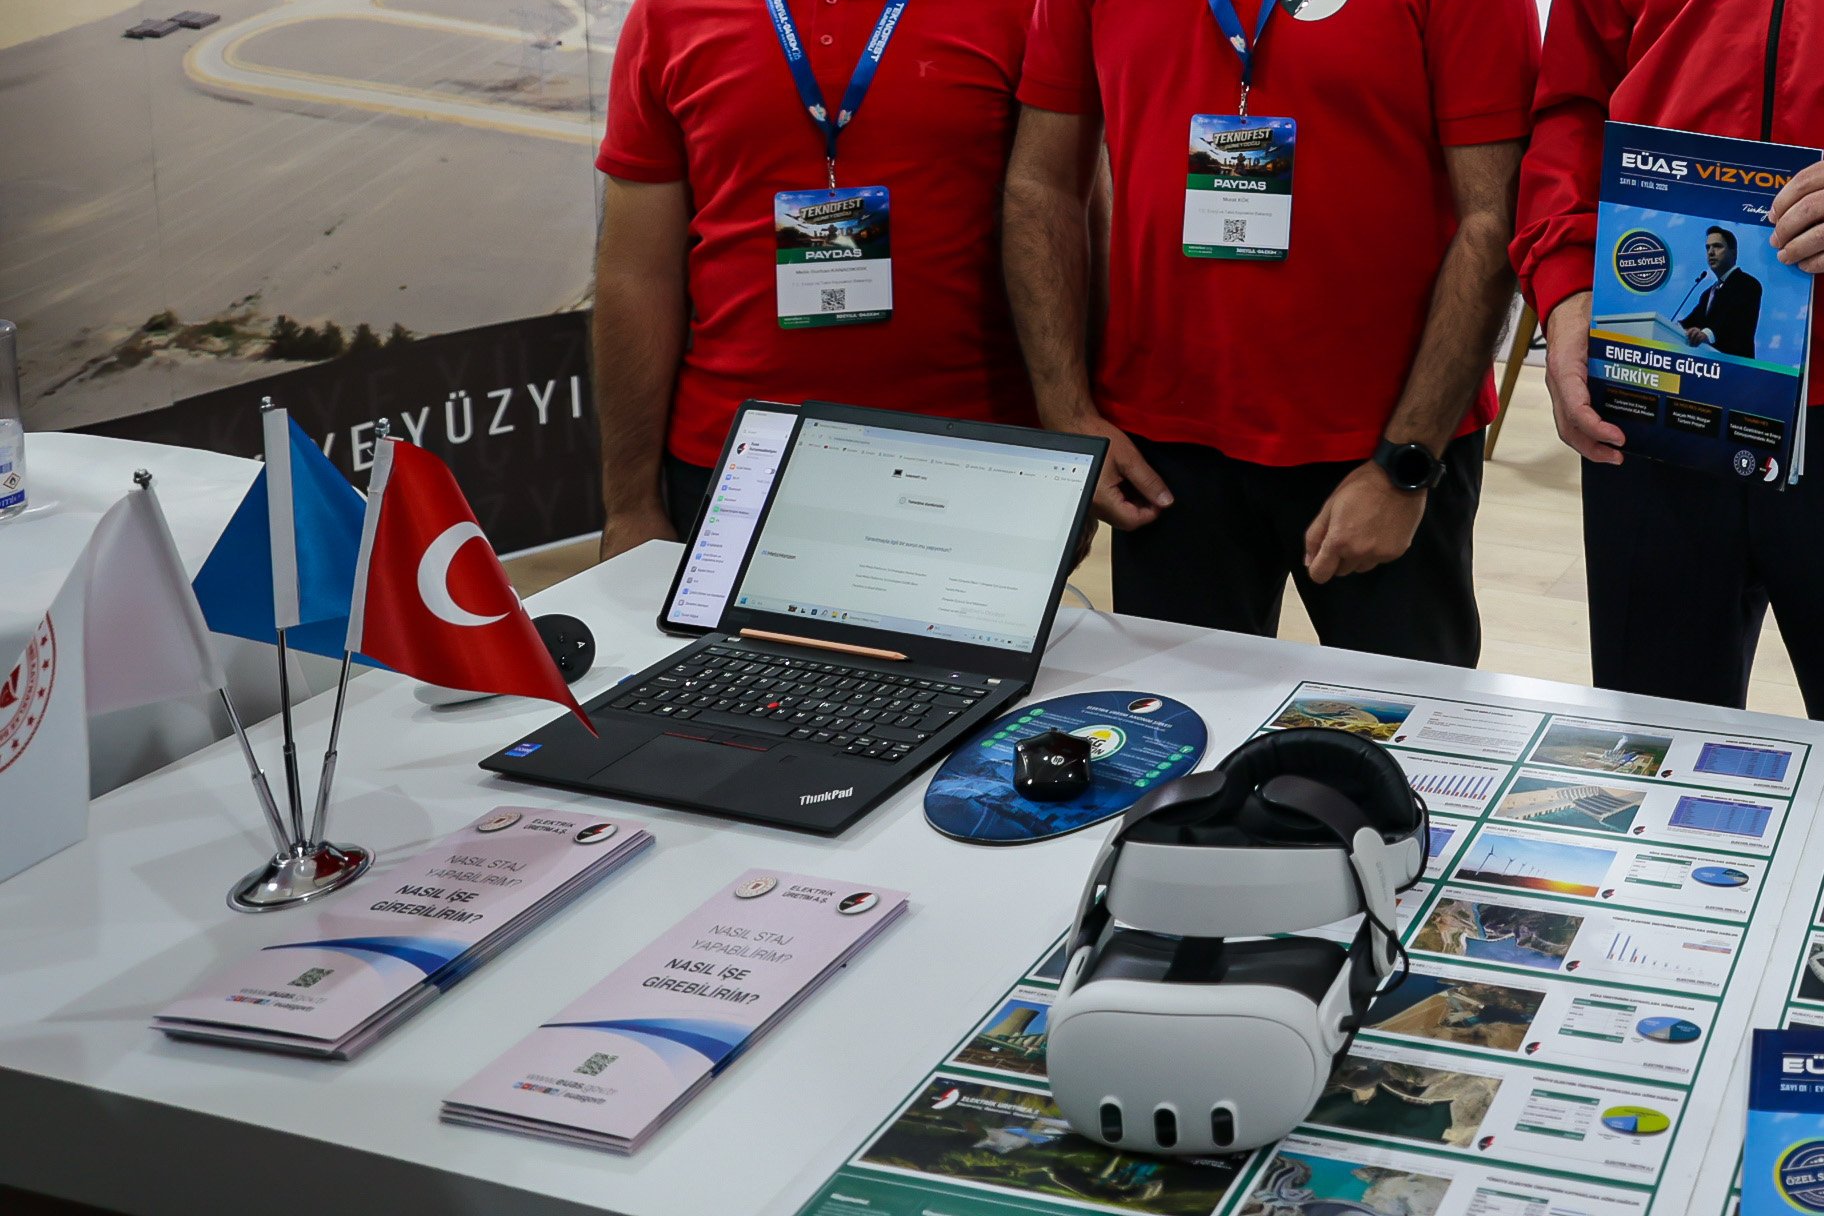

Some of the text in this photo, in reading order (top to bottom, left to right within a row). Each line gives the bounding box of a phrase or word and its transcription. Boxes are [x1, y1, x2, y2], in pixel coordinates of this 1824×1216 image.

[871, 2, 904, 62] TEKNOFEST
[1213, 127, 1272, 145] TEKNOFEST
[1621, 151, 1793, 189] EÜAŞ VİZYON
[801, 198, 863, 218] TEKNOFEST
[1619, 255, 1666, 268] ÖZEL SÖYLEŞİ
[1605, 345, 1721, 379] ENERJİDE GÜÇLÜ
[1604, 363, 1659, 387] TÜRKİYE
[401, 375, 582, 447] YÜZYI
[799, 787, 853, 806] ThinkPad
[532, 817, 576, 828] ELEKTRİK
[444, 855, 527, 872] NASIL STAJ
[396, 884, 480, 904] NASIL İŞE
[789, 885, 835, 898] ELEKTRİK
[370, 900, 484, 924] GİREBİLİRİM?
[709, 924, 793, 945] NASIL STAJ
[664, 958, 752, 982] NASIL İŞE
[642, 976, 760, 1005] GİREBİLİRİM?
[1780, 1083, 1797, 1092] SAYI
[1785, 1172, 1816, 1186] ÖZEL
